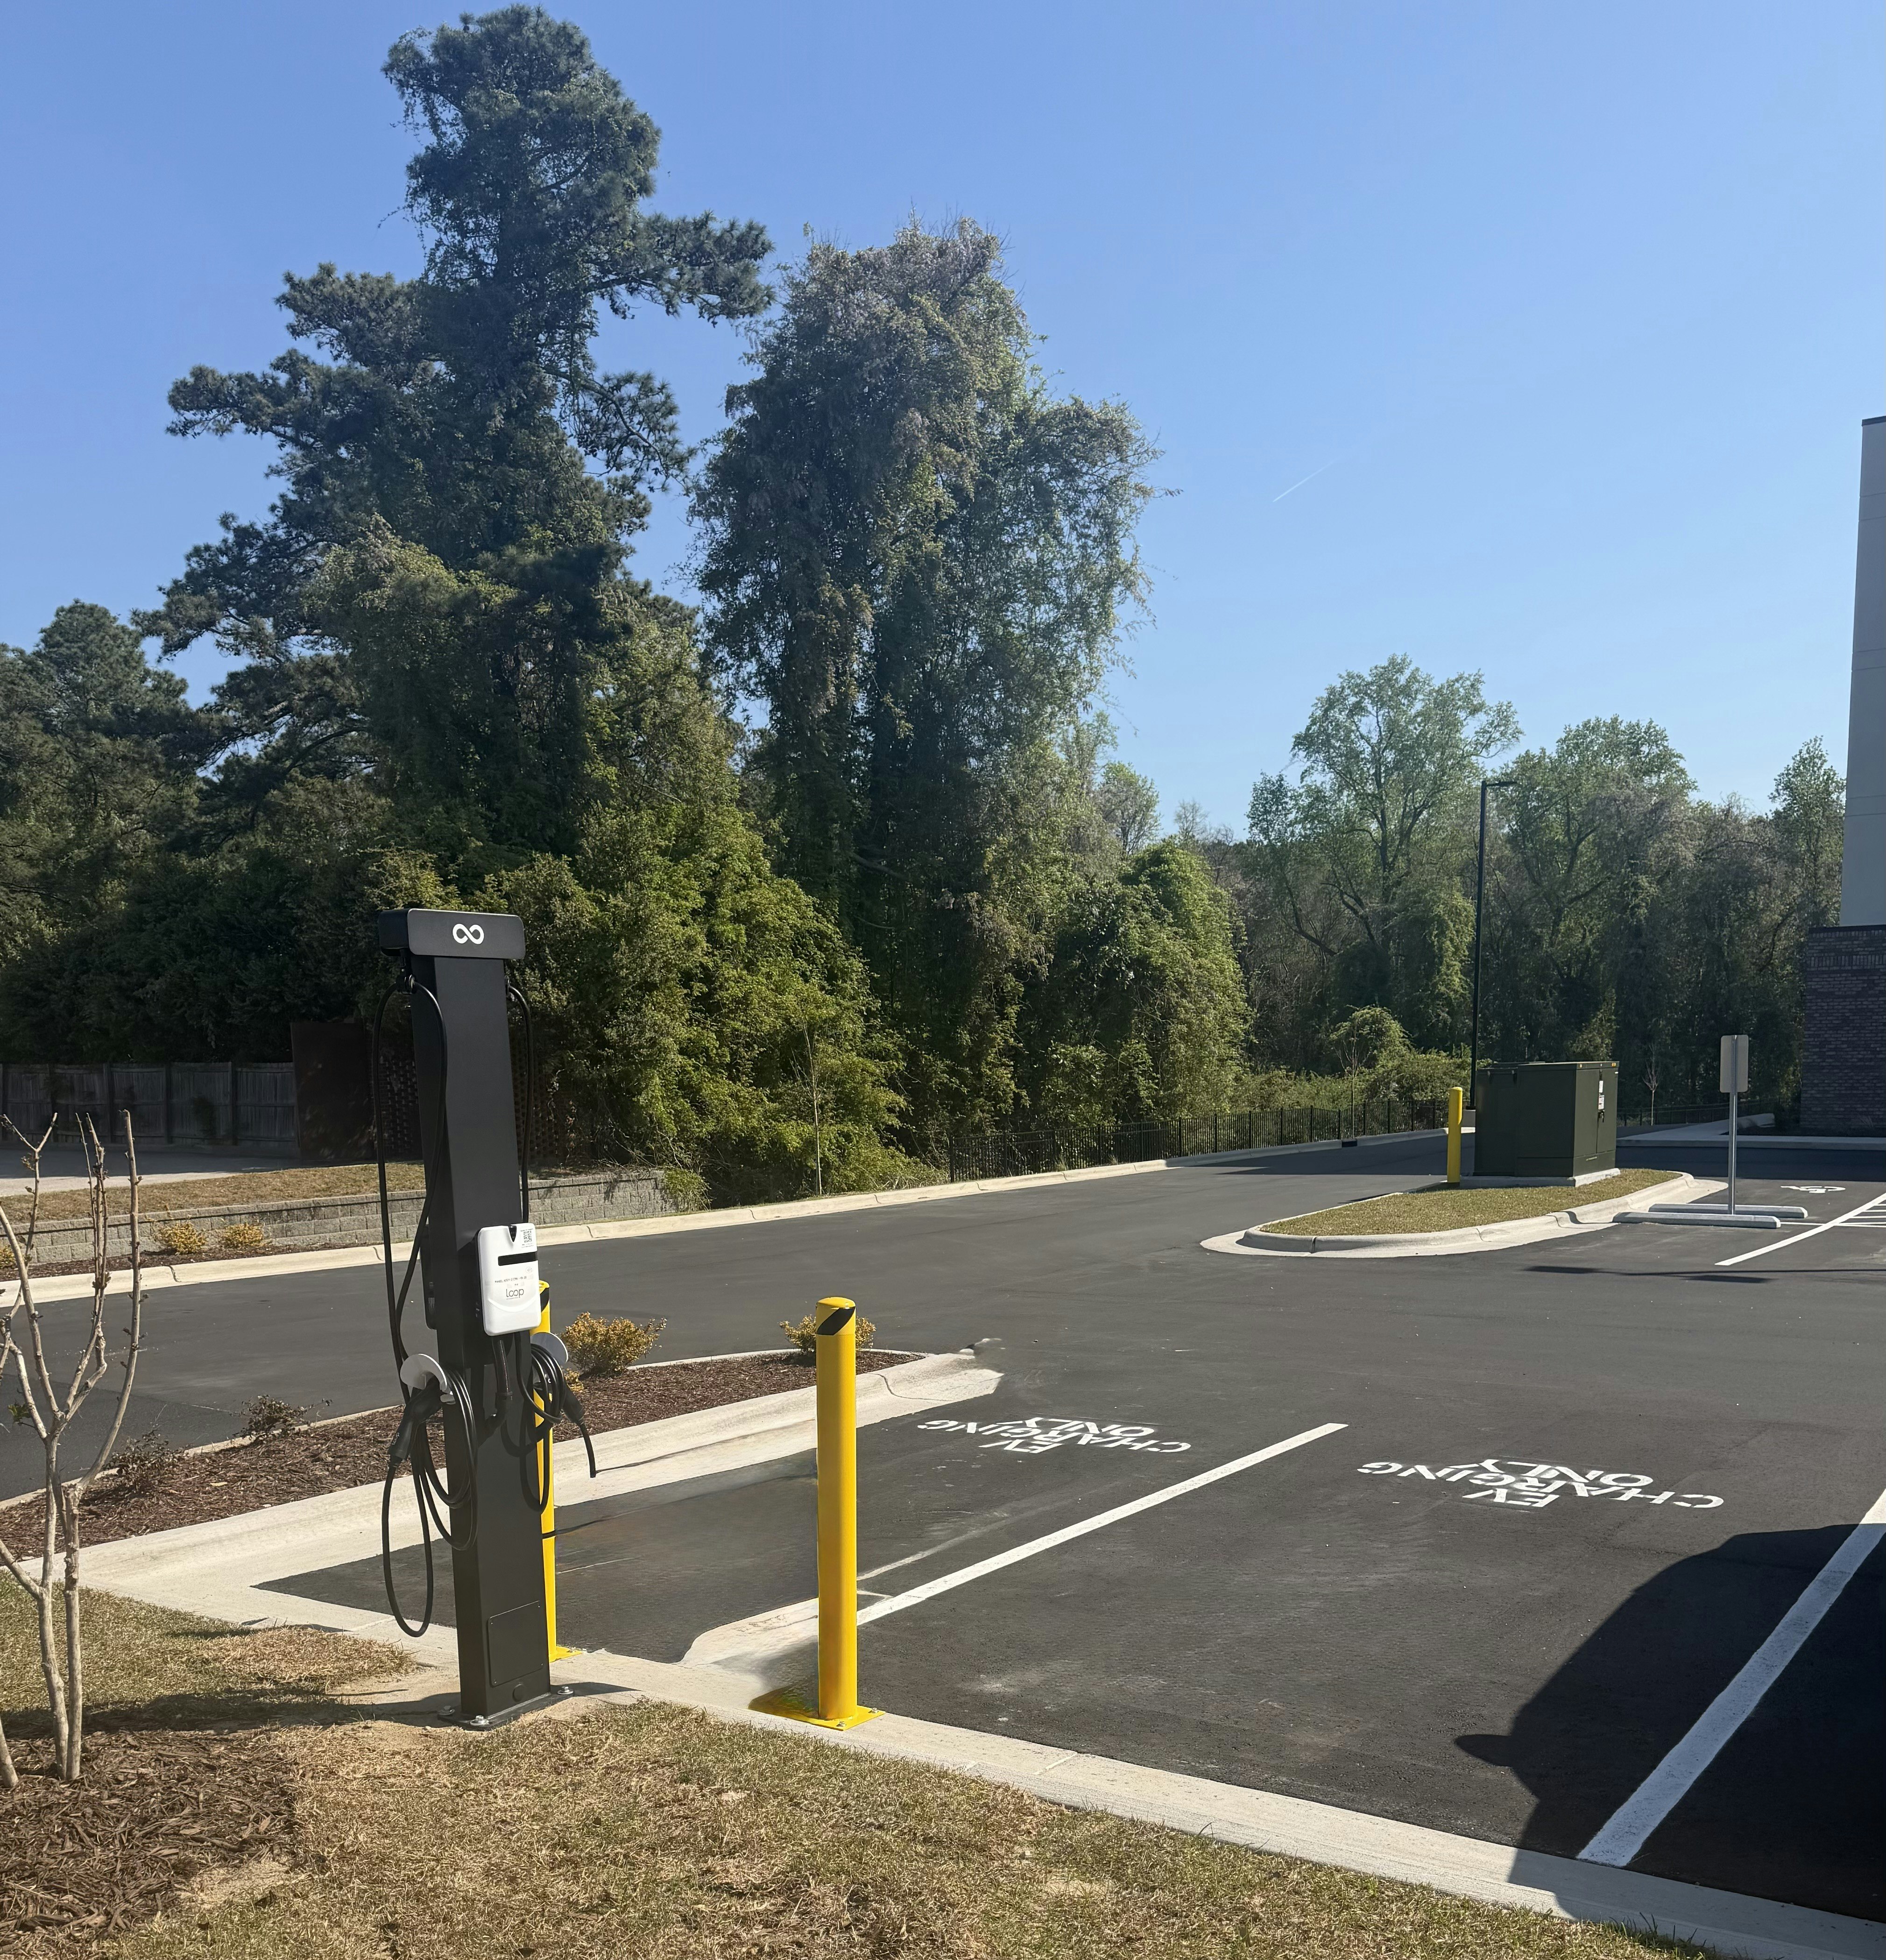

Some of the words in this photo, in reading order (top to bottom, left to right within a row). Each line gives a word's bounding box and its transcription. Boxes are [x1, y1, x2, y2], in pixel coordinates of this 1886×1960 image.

[506, 1289, 524, 1298] loop
[917, 1420, 1191, 1452] CHARGING
[996, 1417, 1155, 1437] ONLY
[978, 1439, 1063, 1453] EV
[1448, 1459, 1653, 1487] ONLY
[1356, 1462, 1724, 1509] CHARGING
[1462, 1488, 1560, 1508] EV
